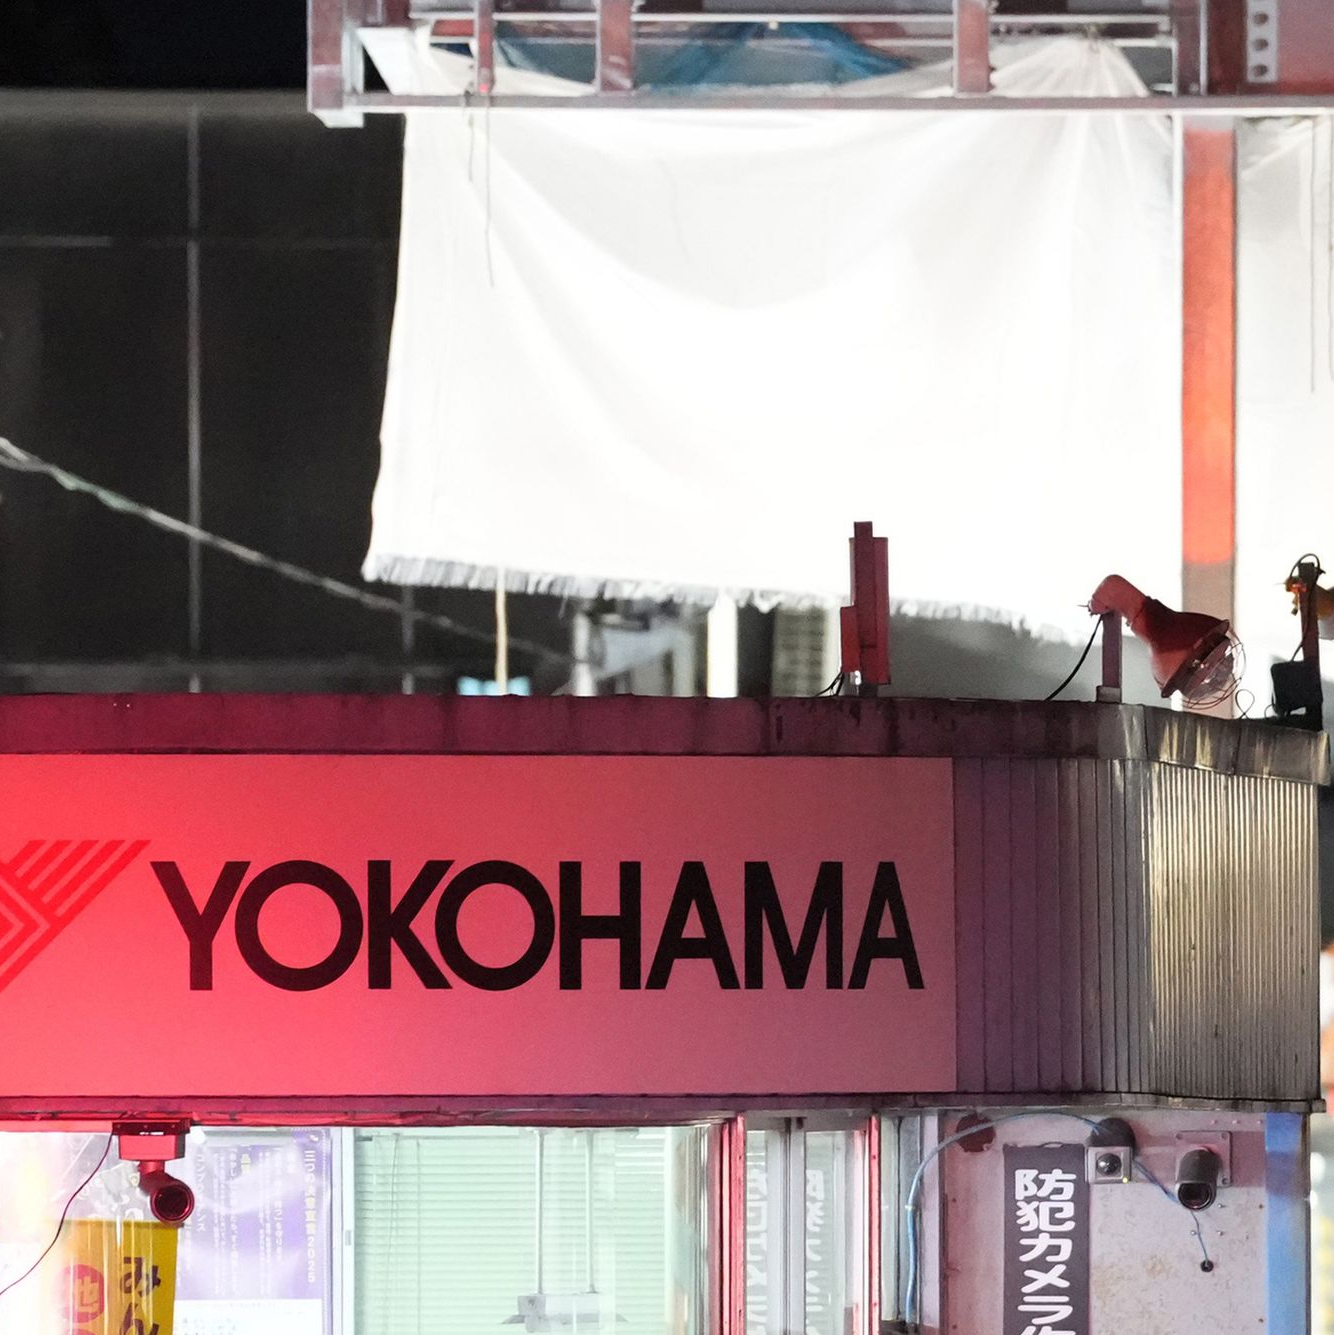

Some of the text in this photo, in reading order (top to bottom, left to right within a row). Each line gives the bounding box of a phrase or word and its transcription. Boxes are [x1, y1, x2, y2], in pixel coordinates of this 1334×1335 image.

[150, 859, 925, 992] YOKOHAMA
[304, 1149, 316, 1283] 三つの2025
